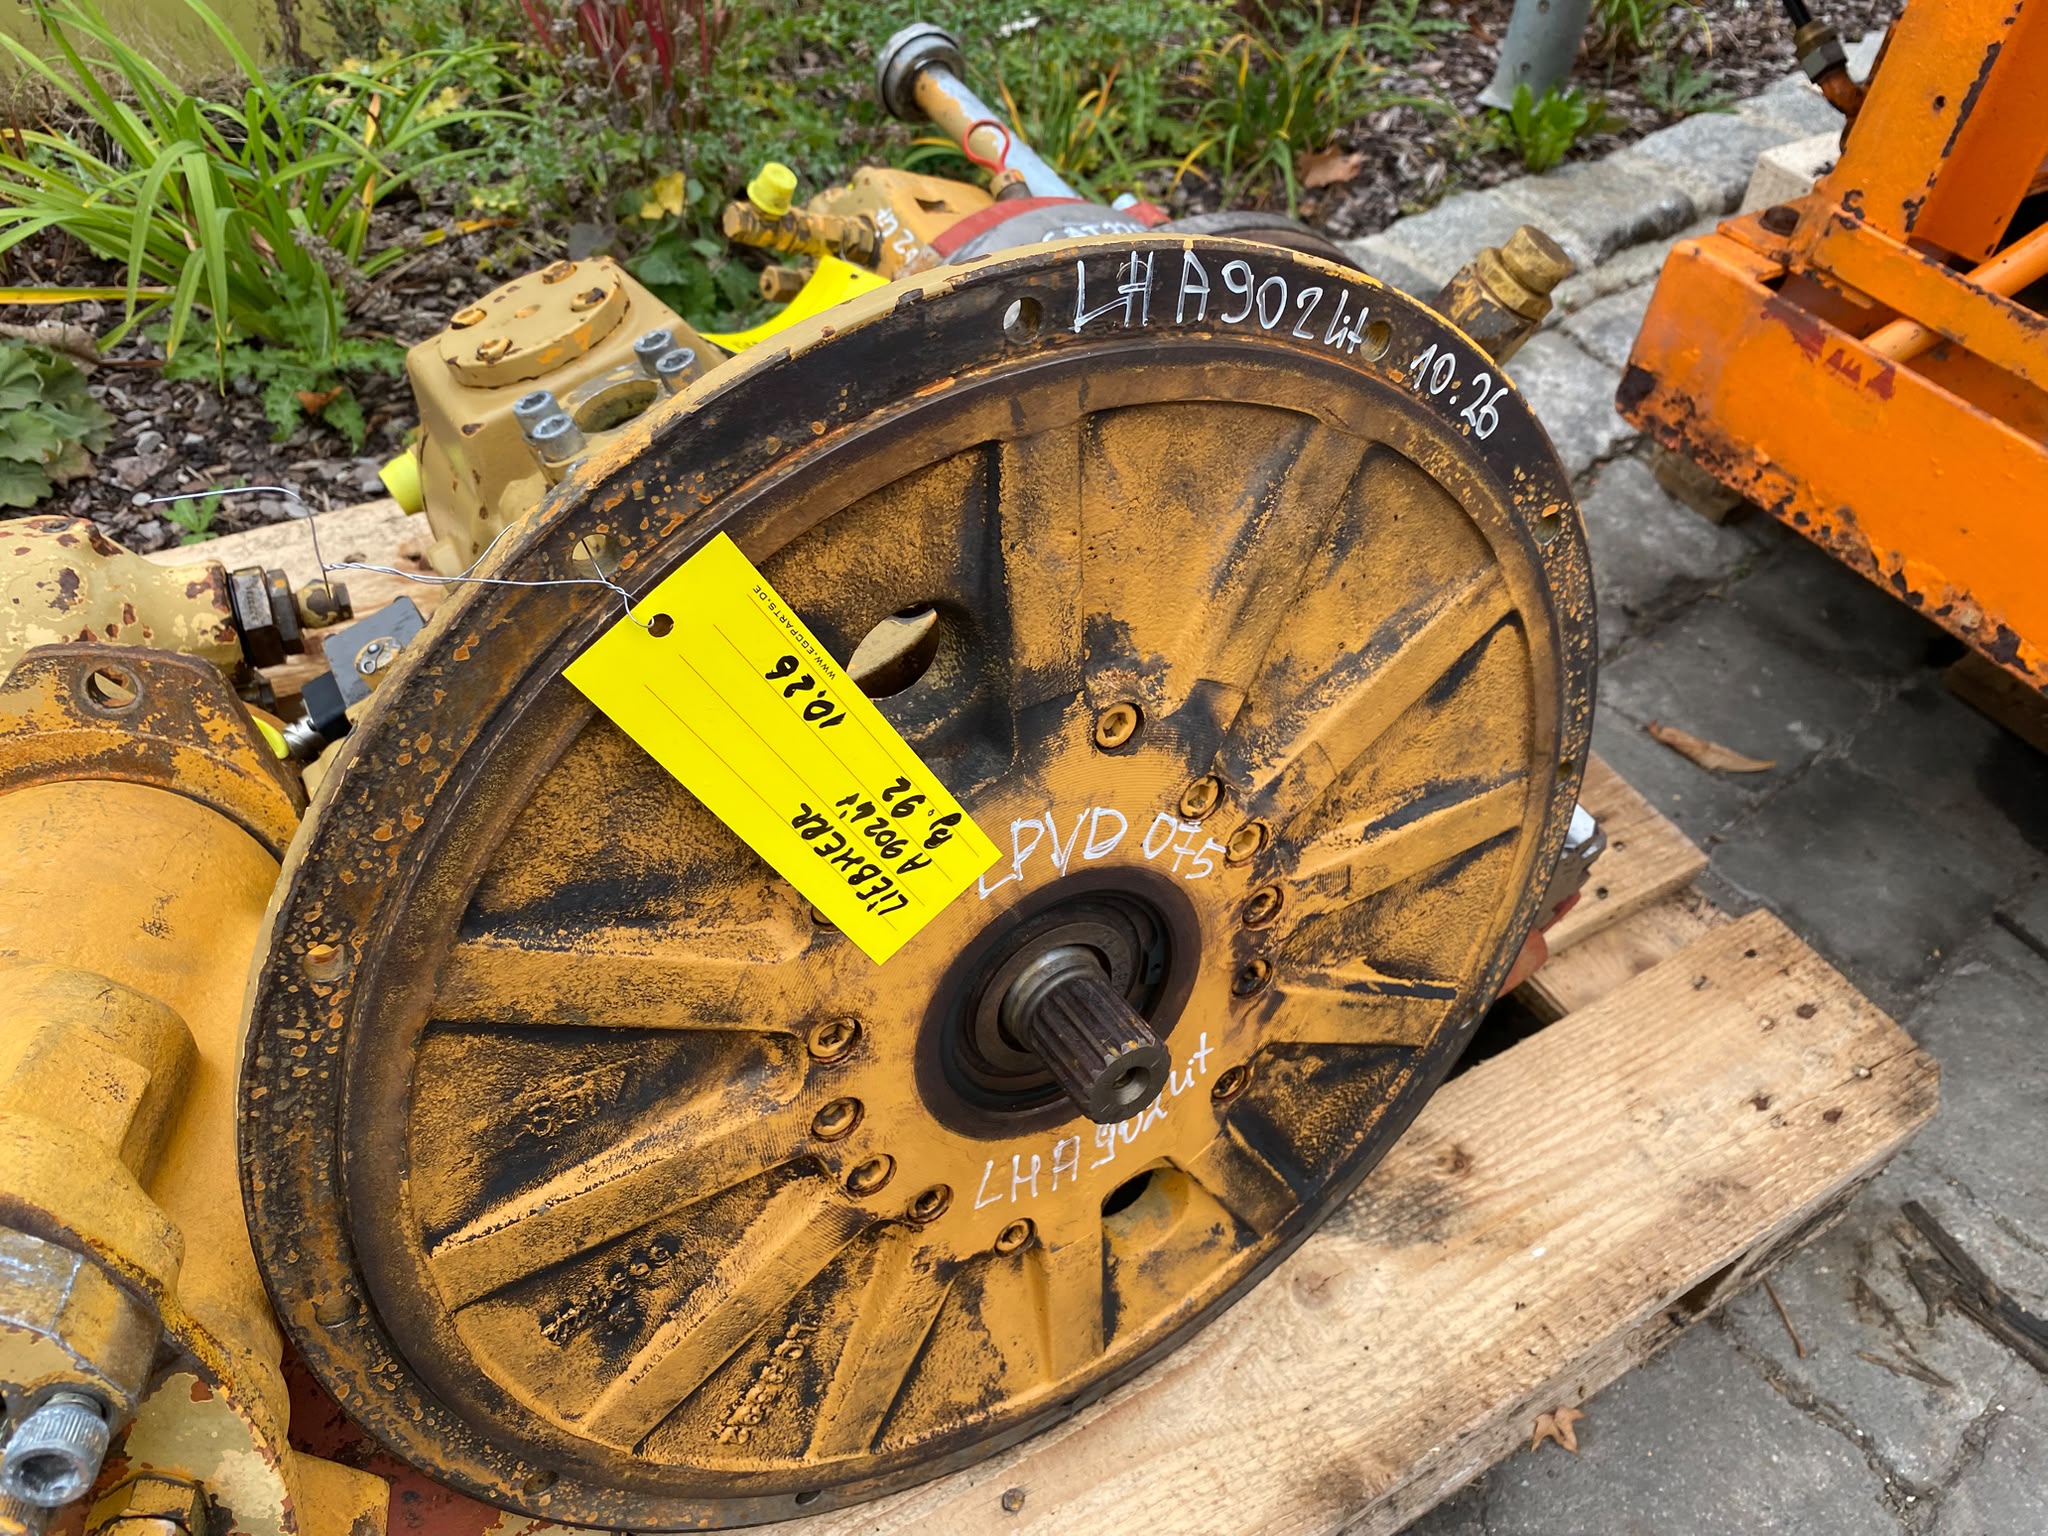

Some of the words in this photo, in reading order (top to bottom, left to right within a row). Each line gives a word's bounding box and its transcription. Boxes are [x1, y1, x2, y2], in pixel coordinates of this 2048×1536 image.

[1069, 250, 1155, 333] LH
[1411, 344, 1508, 440] 10.26
[752, 584, 837, 680] WWW.EGCPARTS.DE
[882, 776, 926, 818] 92
[978, 807, 1128, 899] LPVD
[1142, 813, 1227, 879] 075
